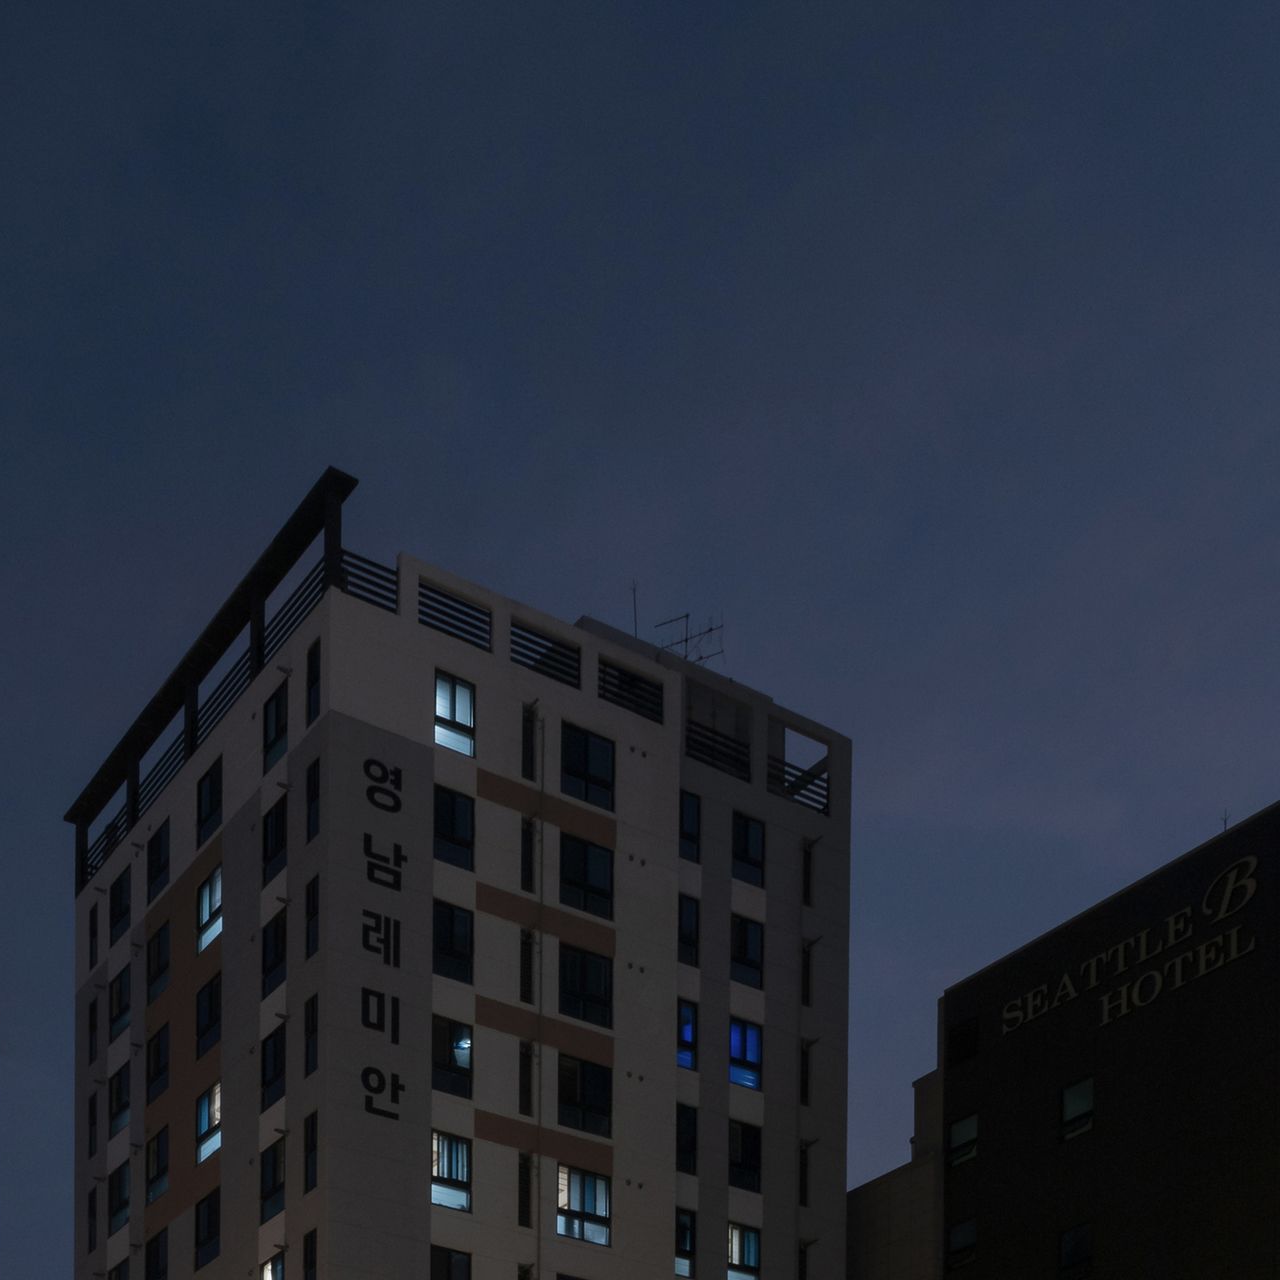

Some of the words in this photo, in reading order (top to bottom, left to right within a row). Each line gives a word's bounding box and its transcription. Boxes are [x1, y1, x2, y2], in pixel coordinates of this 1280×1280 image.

[361, 758, 408, 1120] 영남레미안
[1002, 906, 1193, 1035] SEATTLE
[1201, 855, 1258, 925] B
[1099, 924, 1256, 1027] HOTEL
